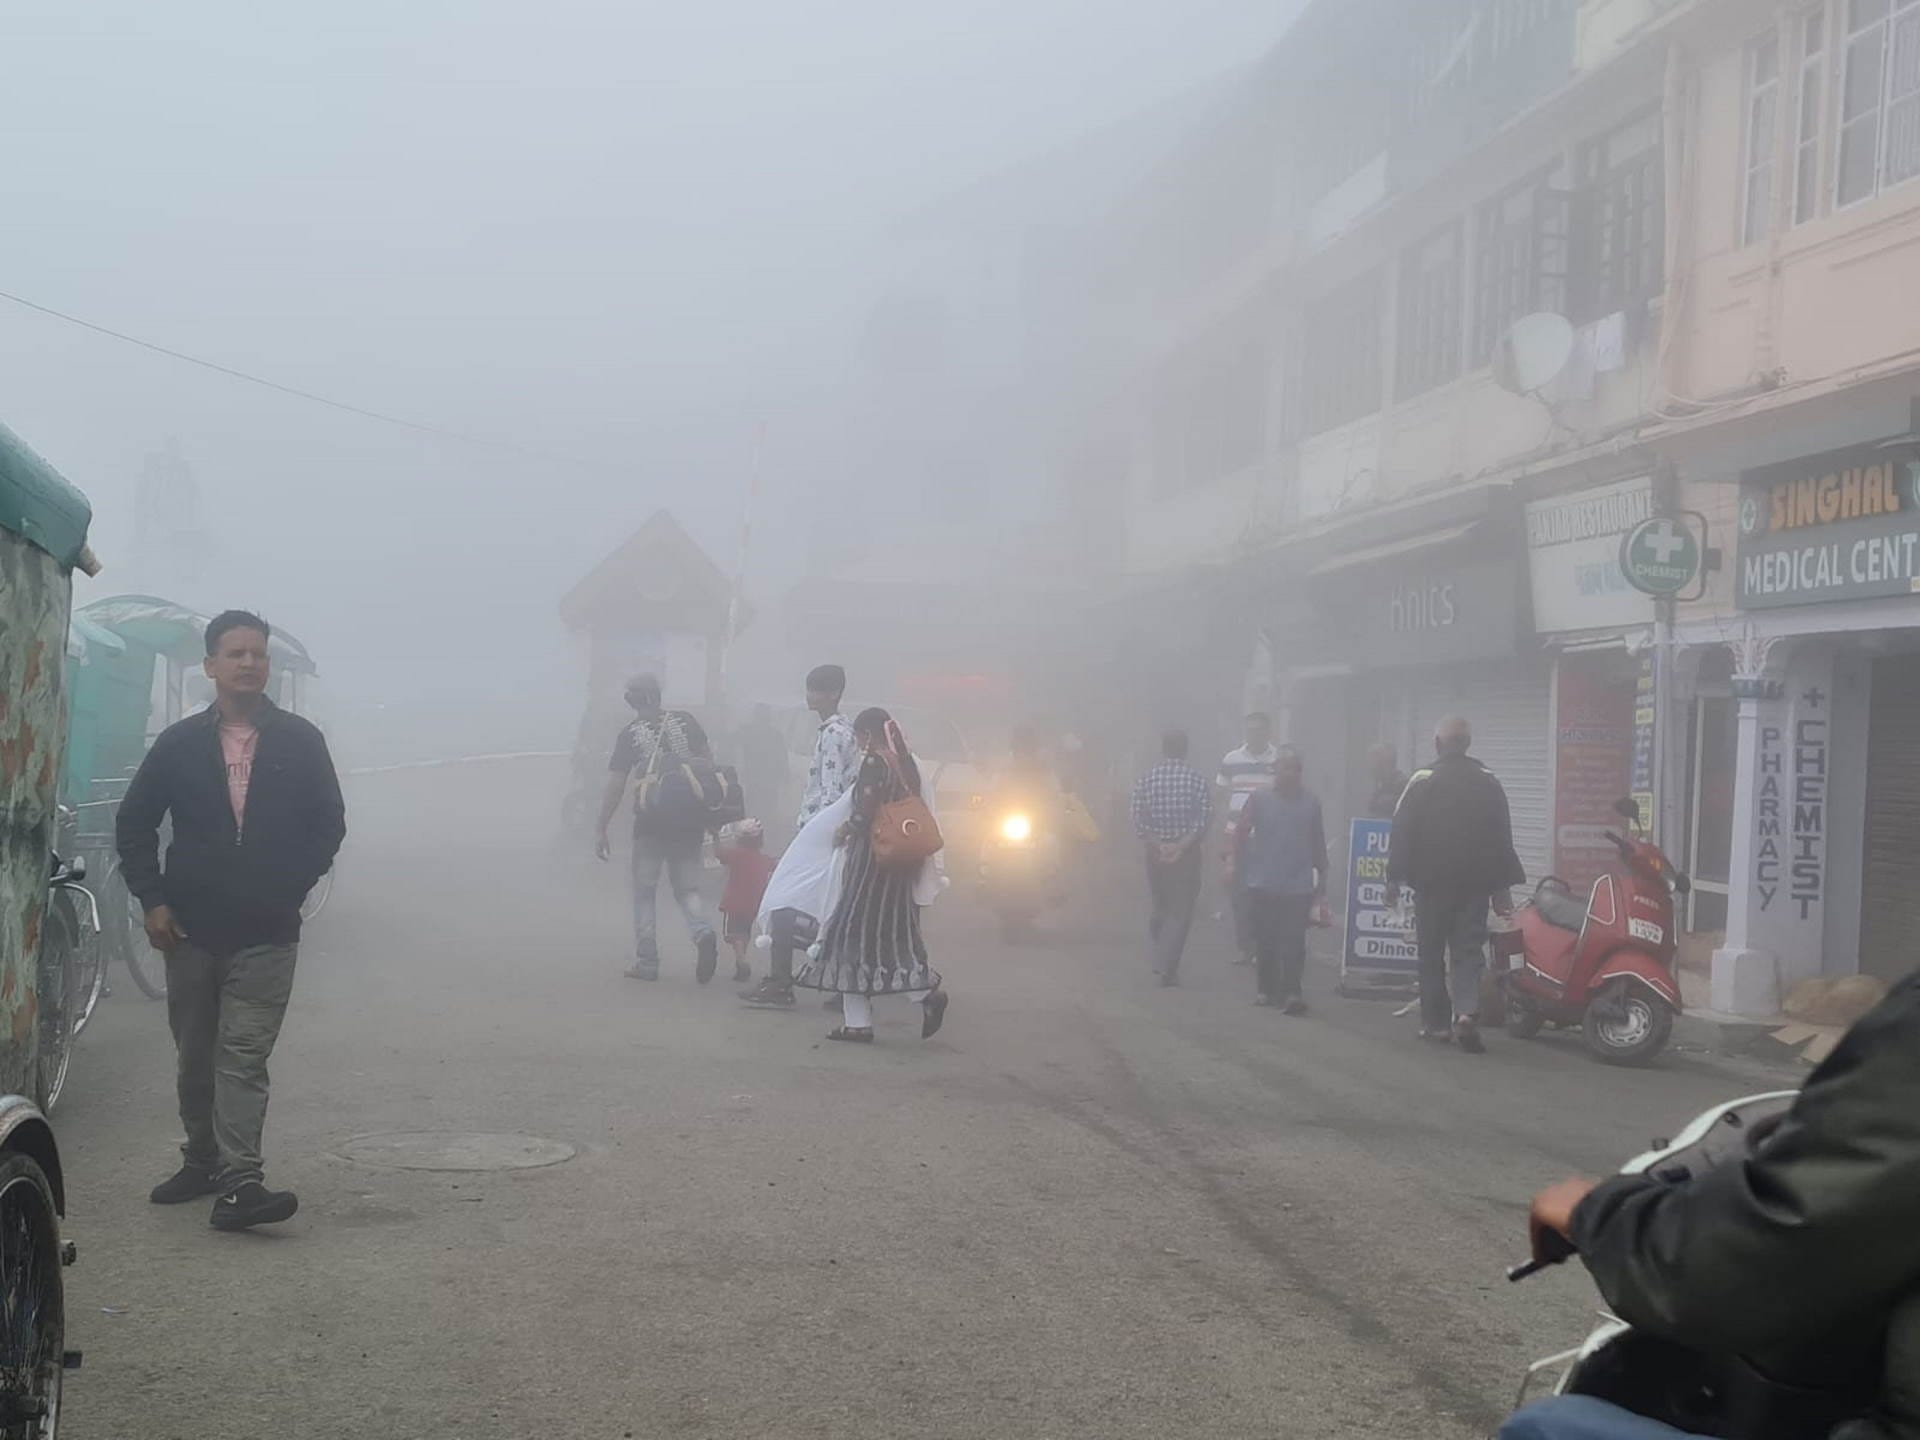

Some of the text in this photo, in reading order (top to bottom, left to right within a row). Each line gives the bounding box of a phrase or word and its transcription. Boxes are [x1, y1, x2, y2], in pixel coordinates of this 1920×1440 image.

[1769, 461, 1900, 530] SINGHAL
[1743, 531, 1920, 597] MEDICAL CENT
[1366, 831, 1391, 853] PU
[1756, 727, 1782, 912] PHARMACY
[1791, 719, 1827, 920] CHEMIST
[1356, 855, 1390, 878] REST
[1366, 940, 1417, 957] Dinne
